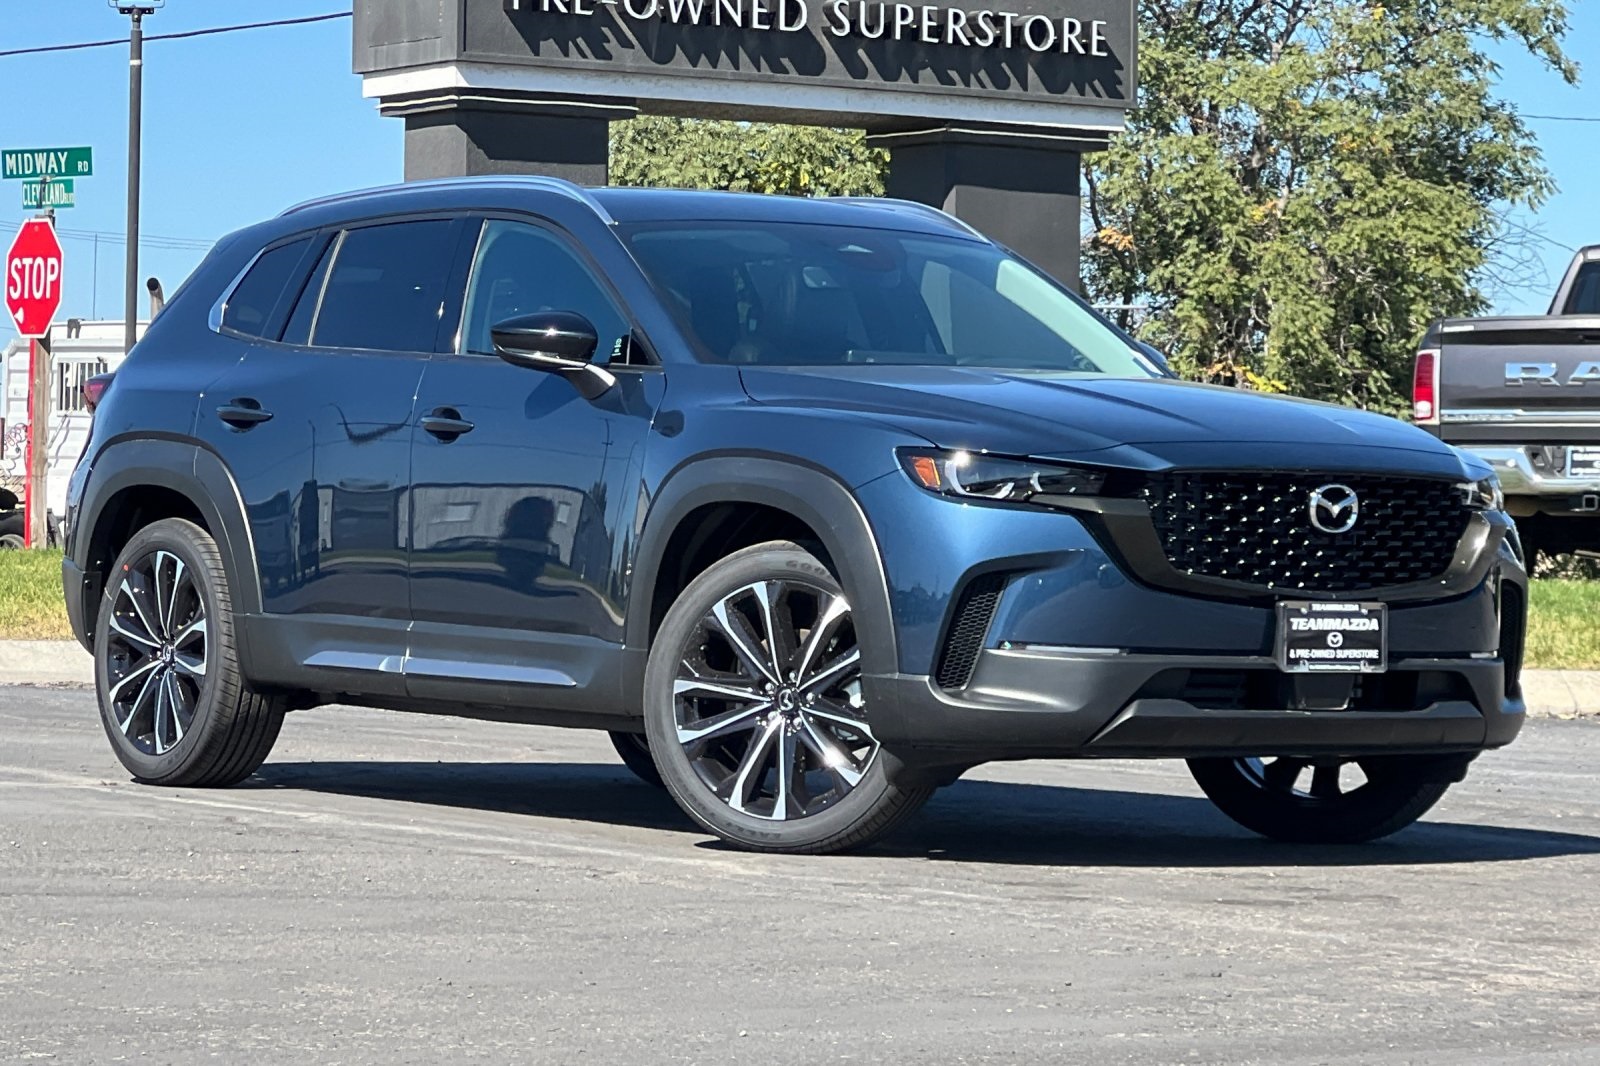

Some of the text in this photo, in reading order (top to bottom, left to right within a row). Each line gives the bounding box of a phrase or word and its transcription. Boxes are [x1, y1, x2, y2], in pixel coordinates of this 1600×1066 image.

[513, 0, 1108, 57] -OWNED SUPERSTORE
[5, 151, 89, 175] MIDWAY RD
[9, 256, 59, 300] STOP
[1296, 649, 1335, 659] PRE-OWNED
[1336, 649, 1379, 659] SUPERSTORE
